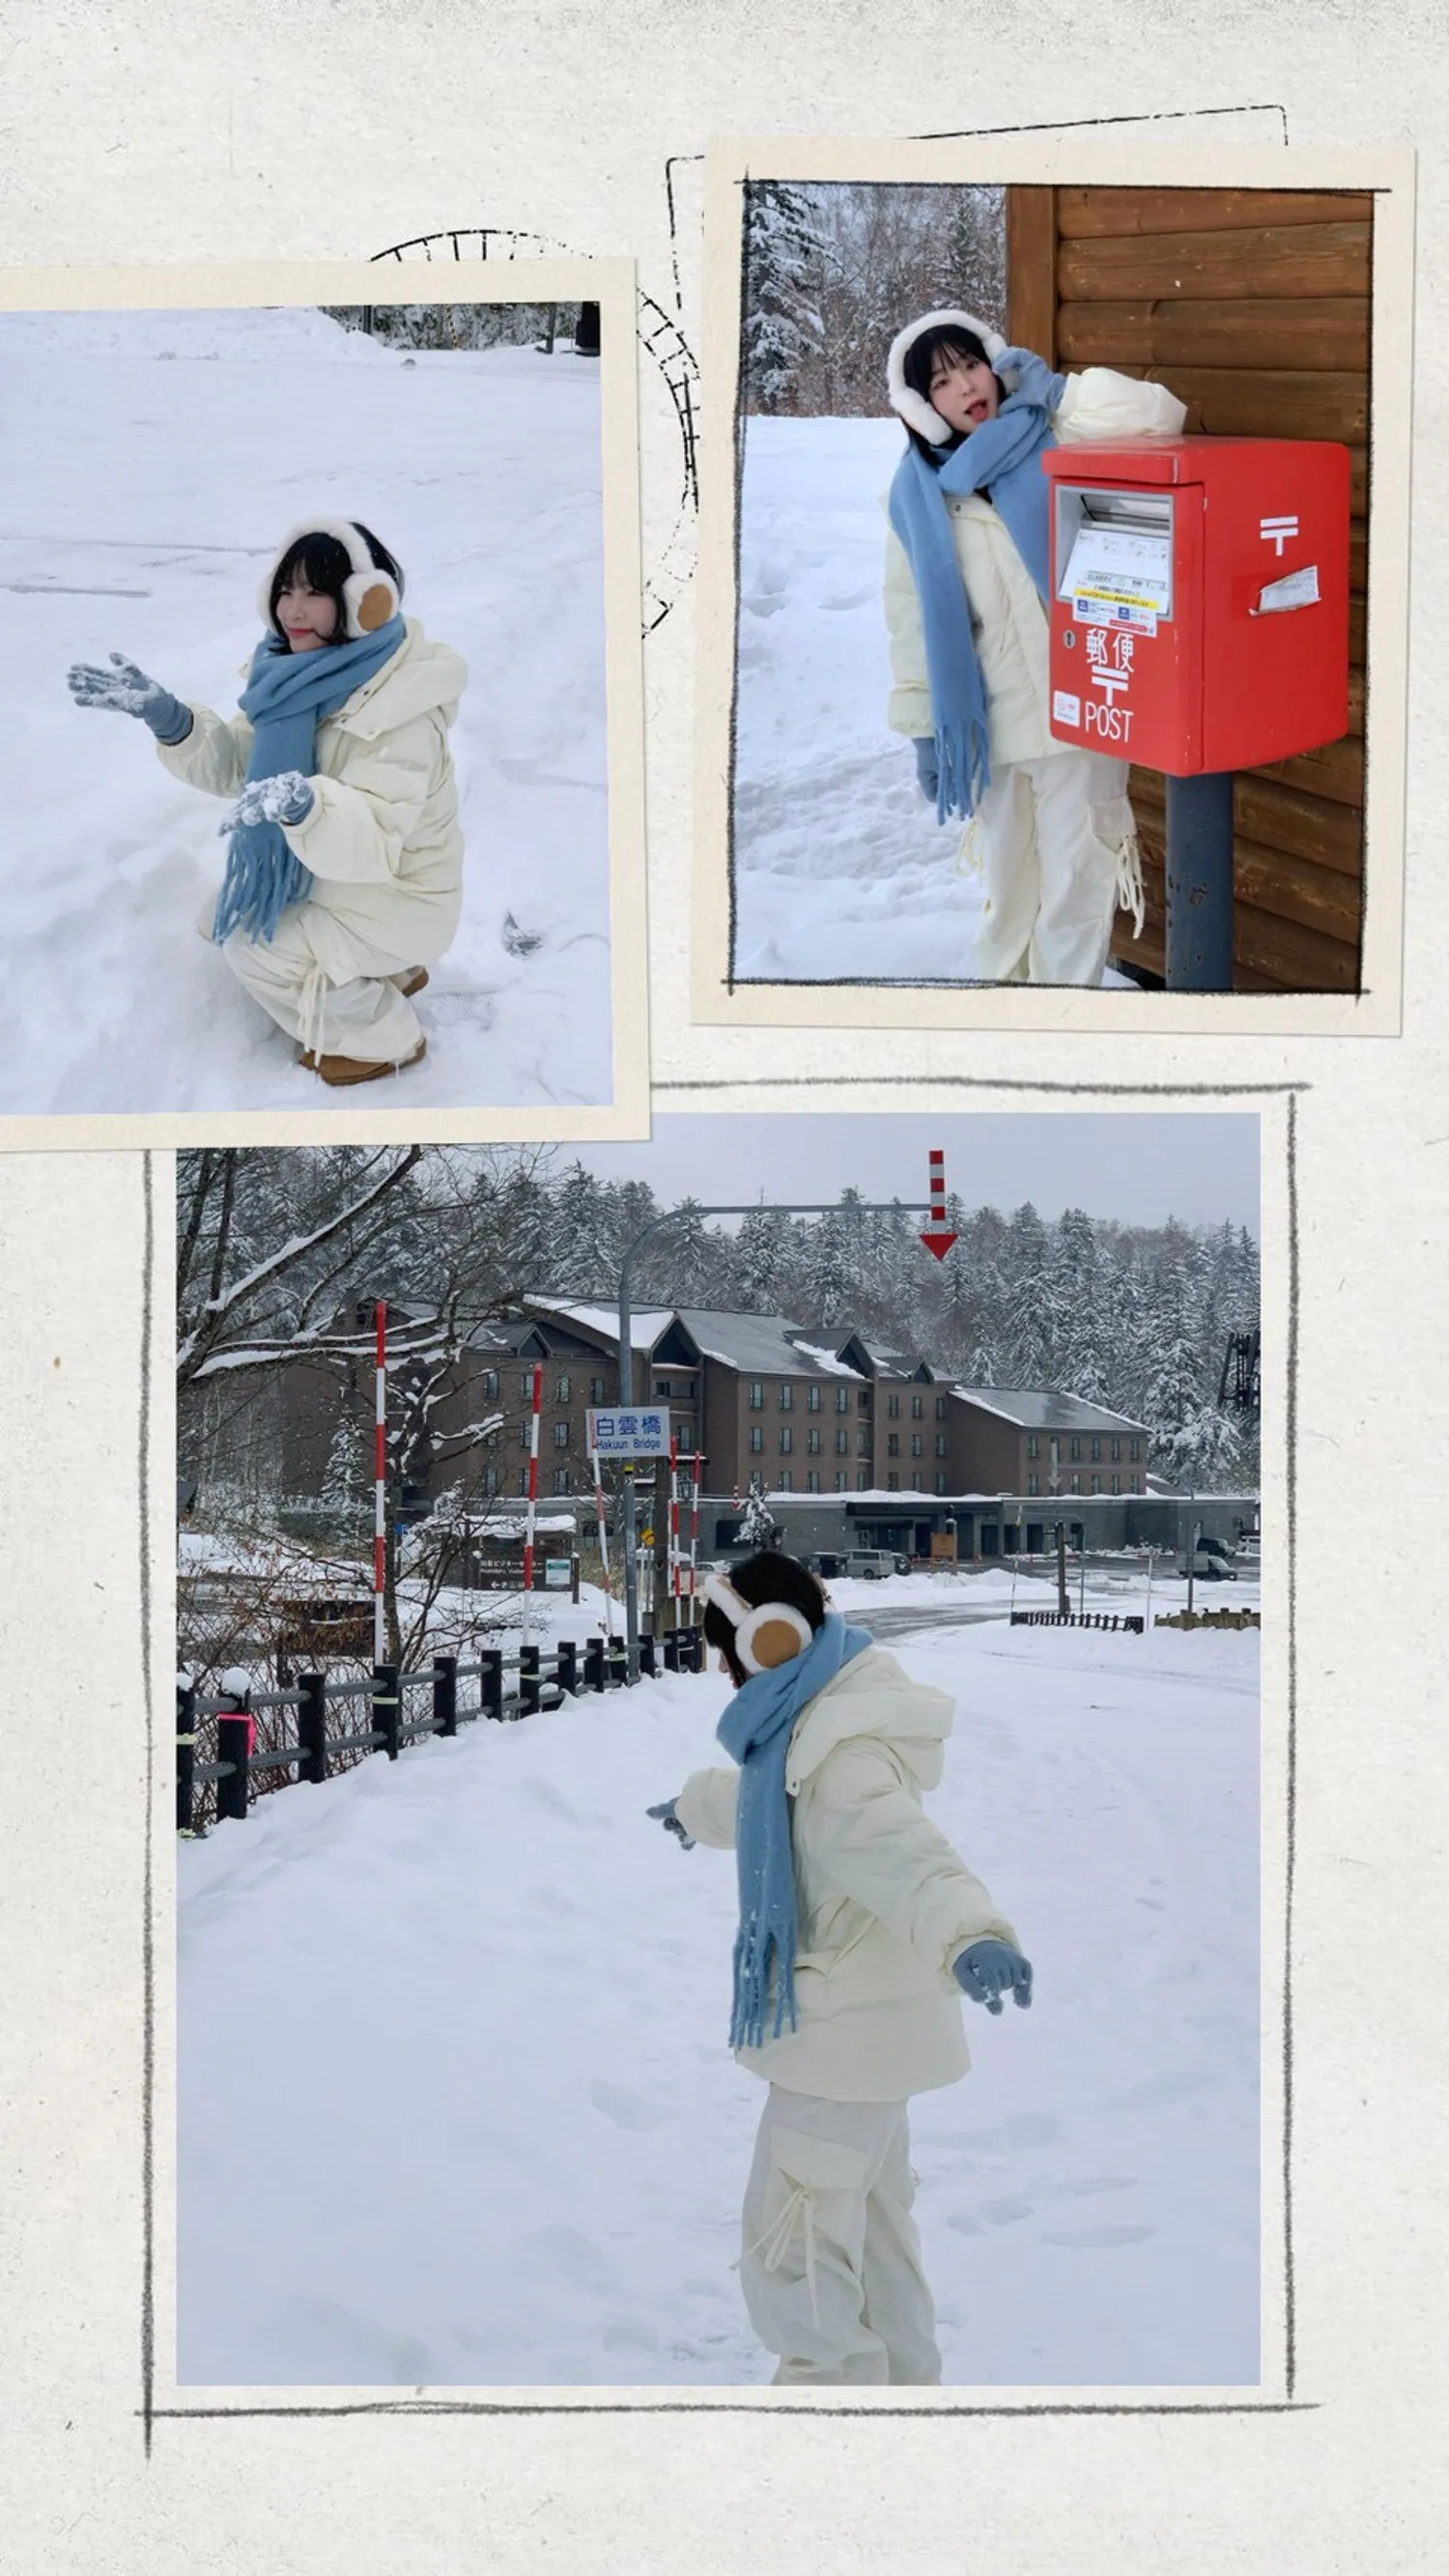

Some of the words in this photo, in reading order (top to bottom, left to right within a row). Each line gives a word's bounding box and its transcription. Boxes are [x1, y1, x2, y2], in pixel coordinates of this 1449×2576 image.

[1086, 628, 1134, 673] 郵便
[1085, 701, 1134, 743] POST
[596, 1415, 661, 1437] 白雲橋
[596, 1439, 628, 1450] Hakuun
[634, 1437, 661, 1450] Bridge
